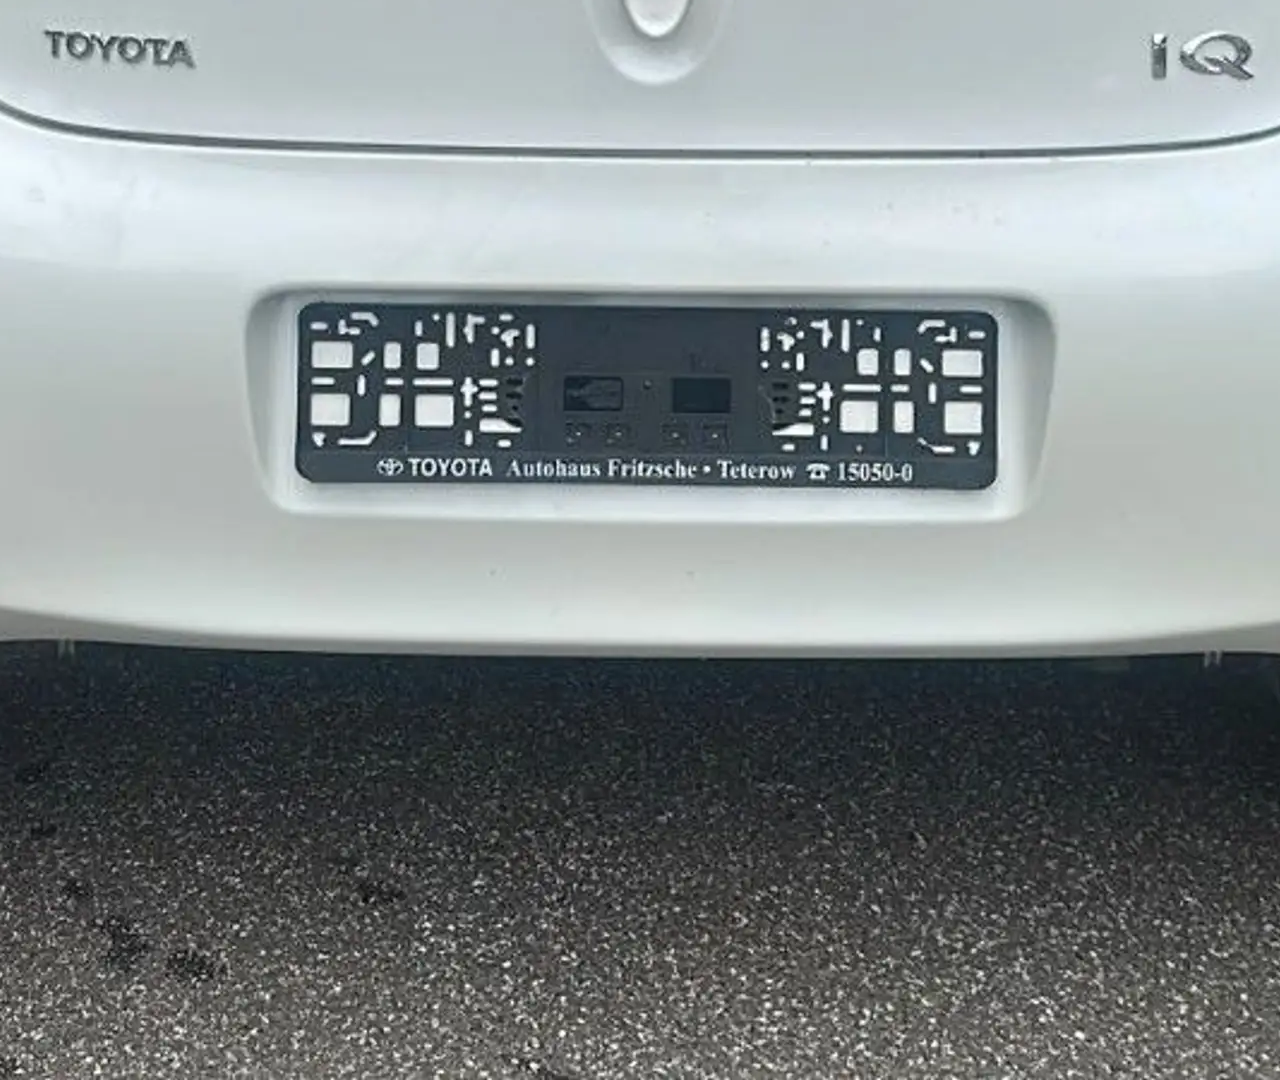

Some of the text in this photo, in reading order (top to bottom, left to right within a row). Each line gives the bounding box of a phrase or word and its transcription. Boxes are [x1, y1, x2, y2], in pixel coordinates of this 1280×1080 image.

[43, 29, 197, 70] TOYOTA
[408, 457, 914, 482] TOYOTA Autohaus Fritzsche Teterow 15050-0
